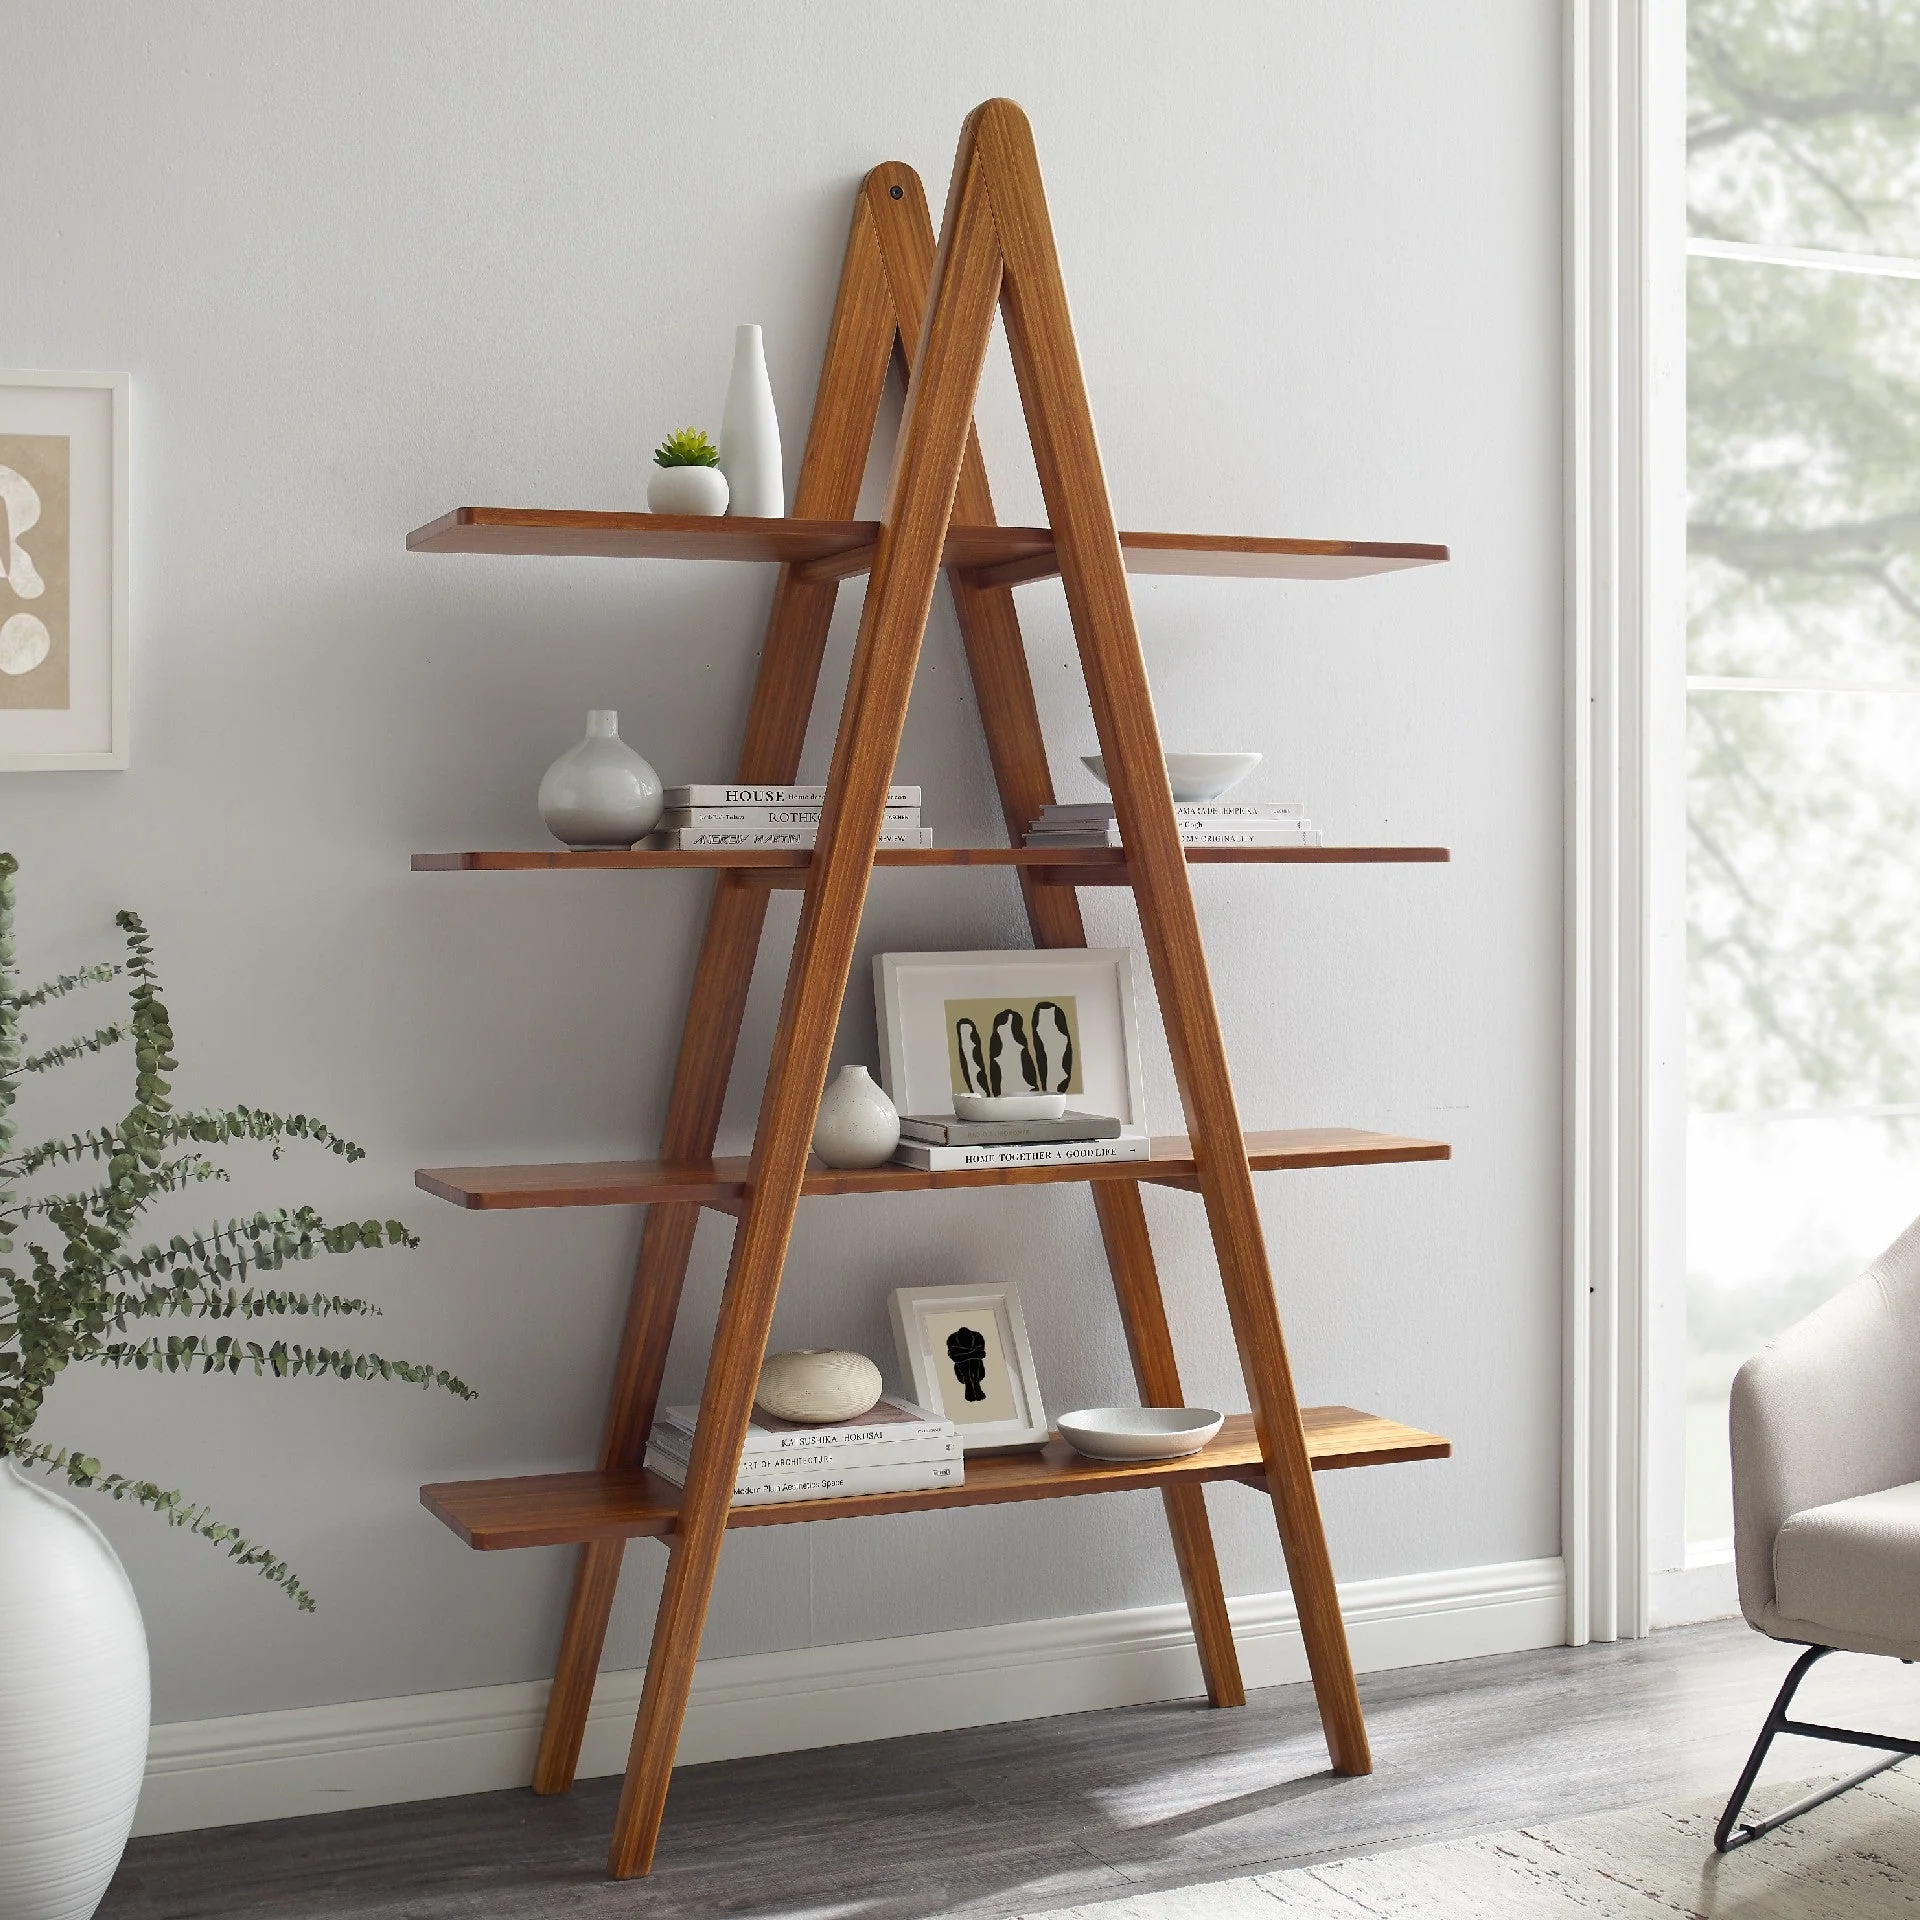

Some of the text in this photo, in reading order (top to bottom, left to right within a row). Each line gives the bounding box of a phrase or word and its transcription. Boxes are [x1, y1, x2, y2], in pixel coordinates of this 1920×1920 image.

[726, 790, 785, 802] HOUSE
[965, 1148, 1117, 1164] HOME TOGETHER A GOOD LIFE
[781, 1431, 883, 1447] KASUSHIKA HOKUSAI
[743, 1456, 833, 1470] ART OF ARCHITECTURE
[821, 1479, 844, 1489] Space
